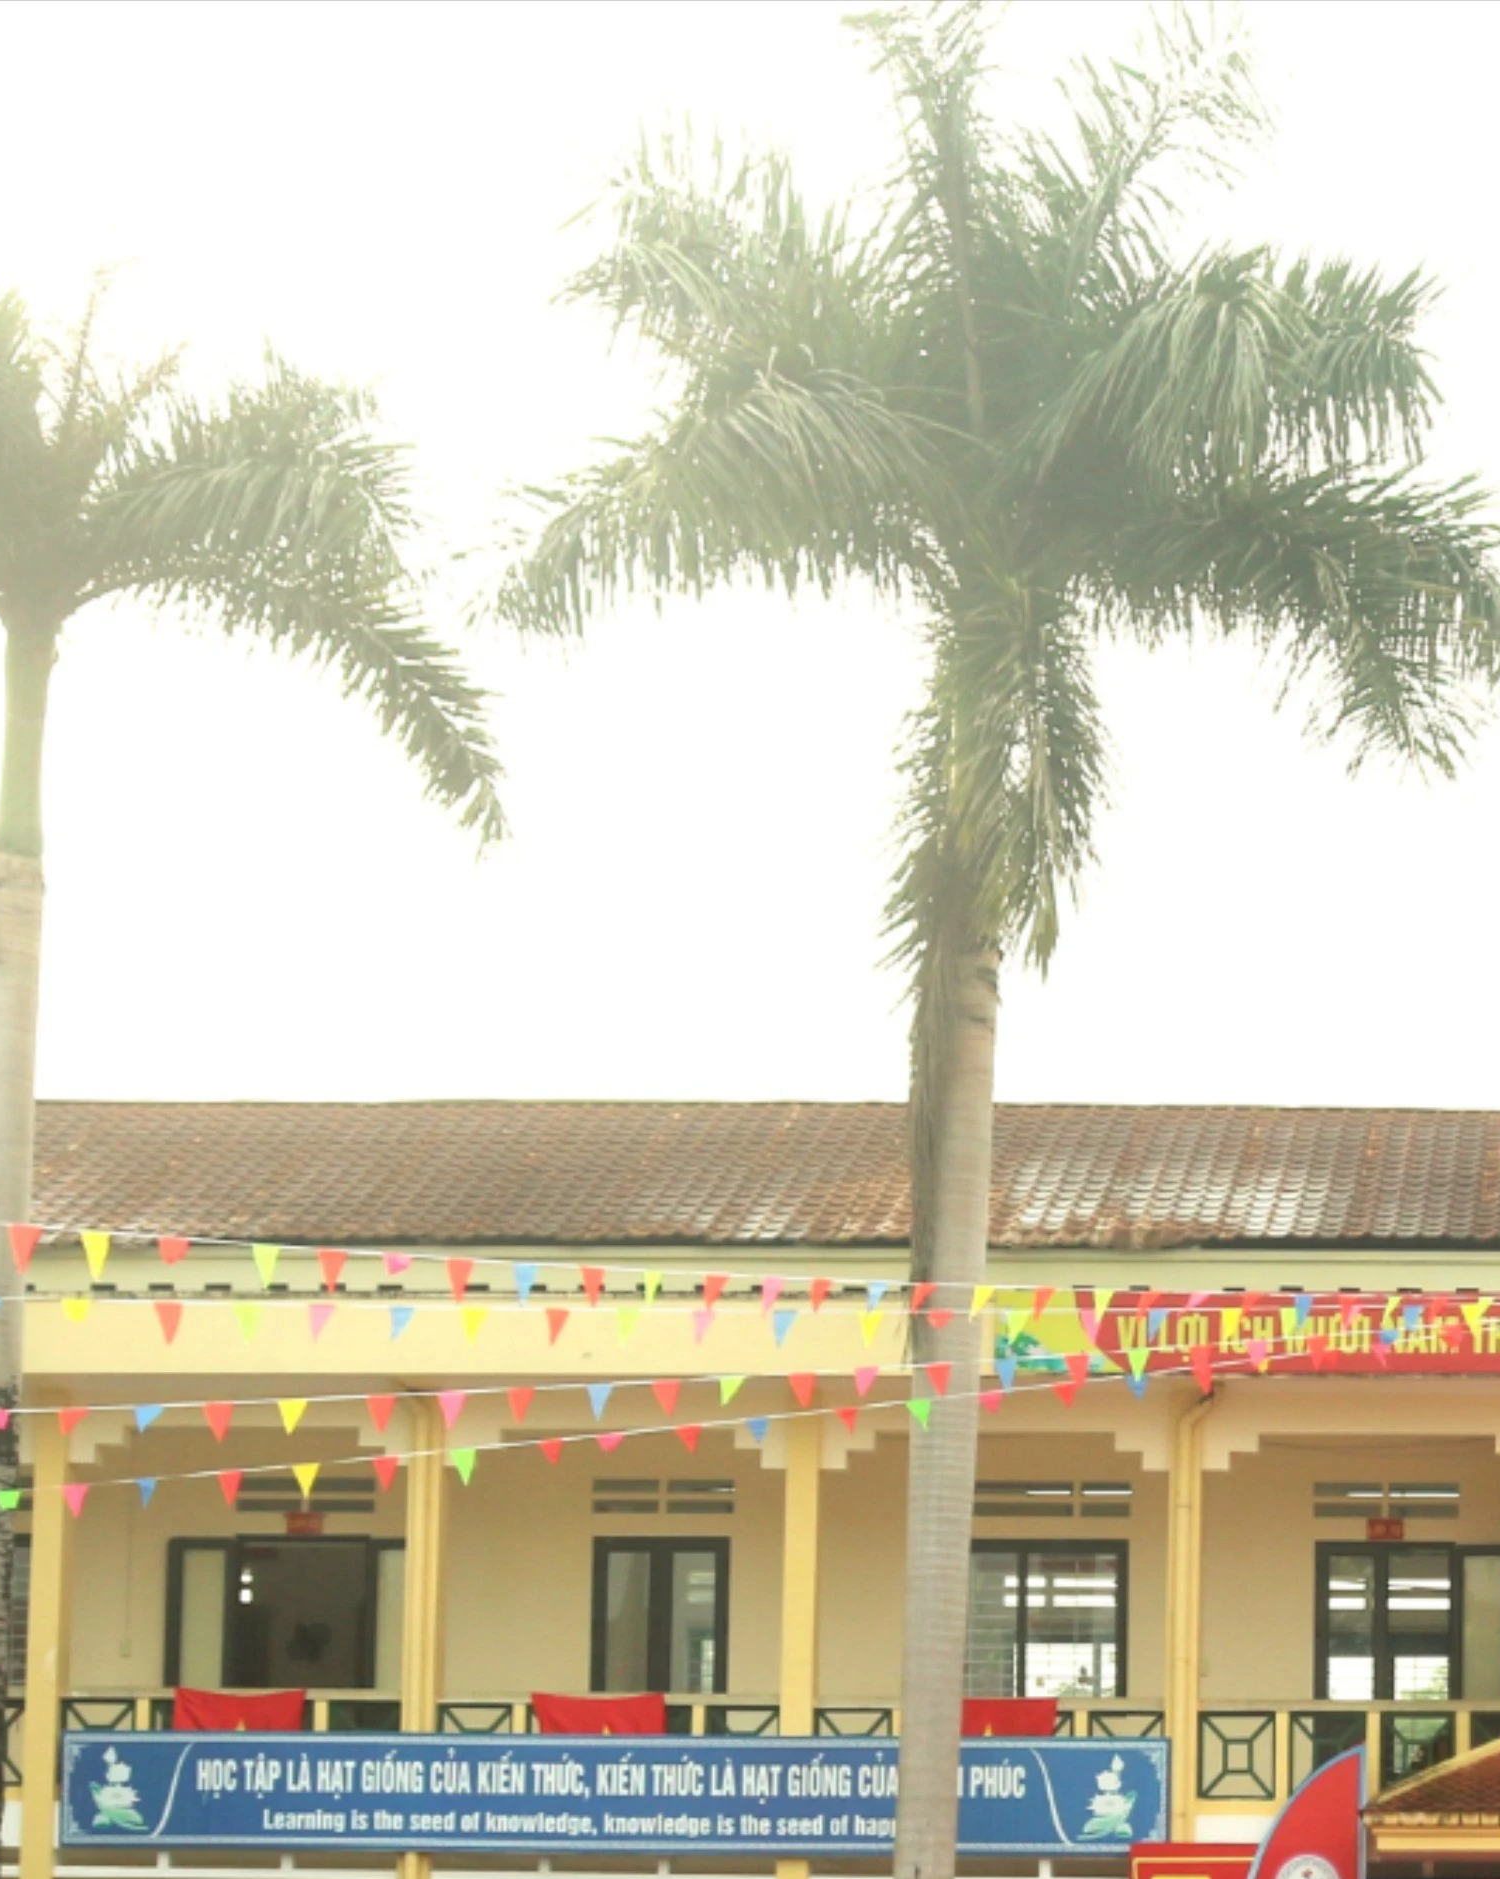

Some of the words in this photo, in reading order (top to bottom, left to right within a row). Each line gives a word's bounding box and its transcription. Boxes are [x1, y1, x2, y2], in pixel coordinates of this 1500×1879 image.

[196, 1759, 237, 1799] HỌC
[244, 1753, 281, 1799] TẬP
[286, 1754, 312, 1793] LÀ
[317, 1759, 357, 1800] HẠT
[361, 1750, 424, 1794] GIỐNG
[430, 1748, 471, 1795] CỦA
[477, 1750, 526, 1795] KIẾN
[531, 1754, 590, 1799] THỨC,
[596, 1752, 645, 1797] KIẾN
[651, 1755, 705, 1797] THỨC
[710, 1758, 736, 1797] LÀ
[742, 1764, 783, 1804] HẠT
[788, 1752, 852, 1798] GIỐNG
[858, 1751, 899, 1798] CỦA
[970, 1759, 1027, 1799] PHÚC
[263, 1809, 346, 1833] Learning
[351, 1810, 368, 1831] is
[374, 1810, 403, 1831] the
[410, 1811, 456, 1832] seed
[461, 1812, 481, 1833] of
[485, 1812, 597, 1836] knowledge,
[603, 1813, 711, 1837] knowledge
[717, 1815, 735, 1835] is
[740, 1815, 771, 1836] the
[776, 1814, 824, 1836] seed
[830, 1815, 849, 1836] of
